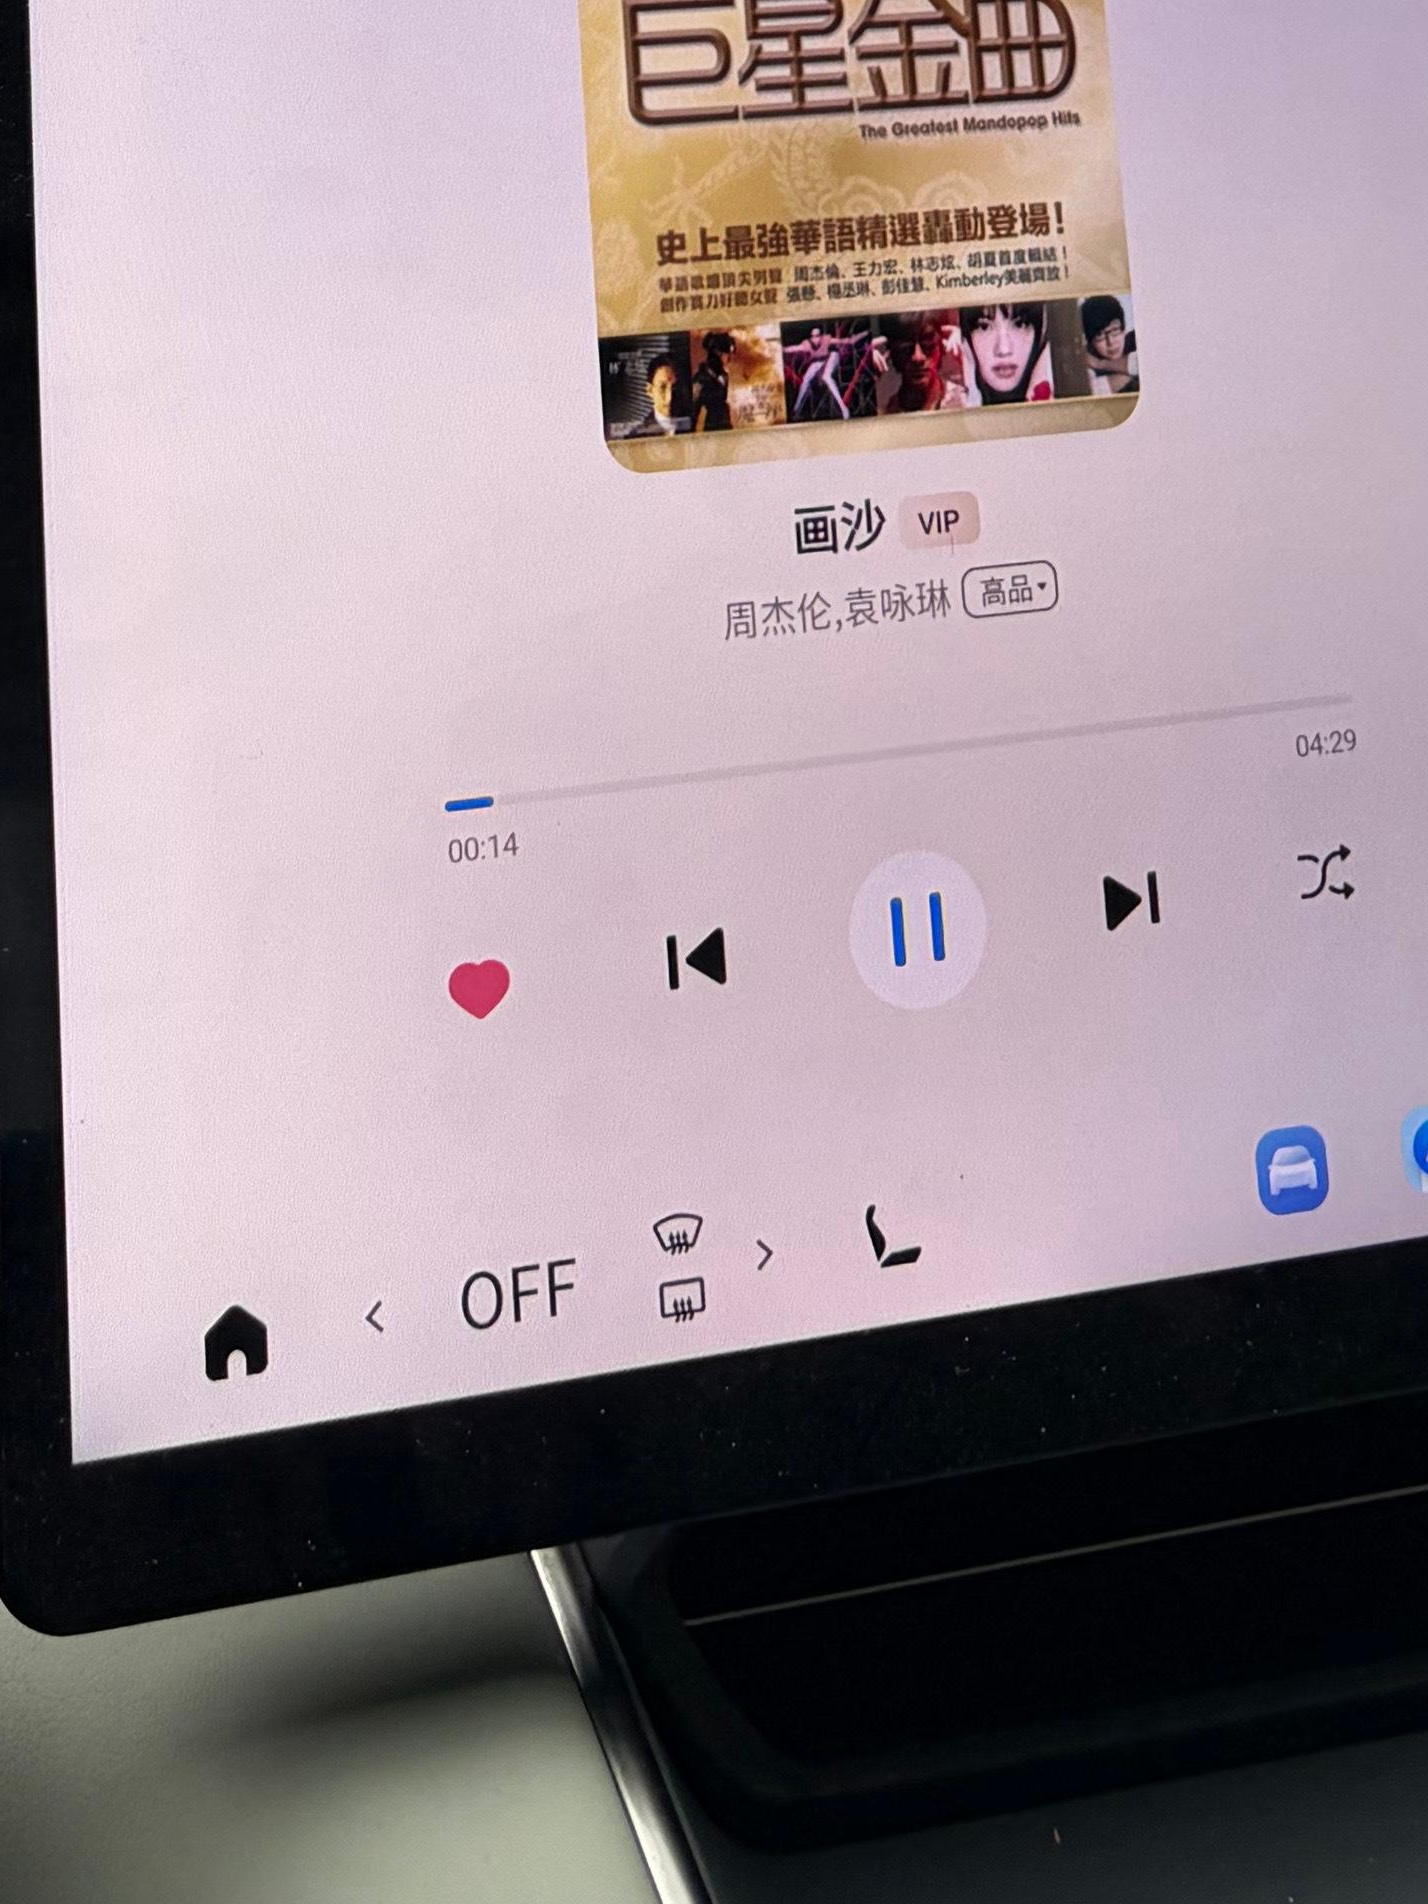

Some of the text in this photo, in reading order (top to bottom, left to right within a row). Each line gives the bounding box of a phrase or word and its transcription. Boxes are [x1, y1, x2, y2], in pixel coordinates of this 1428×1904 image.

[859, 111, 1080, 139] The Greatest Mandopop Hits
[794, 499, 960, 554] 画沙 VIP
[725, 574, 1033, 640] 周杰伦,袁咏琳 高品
[1295, 728, 1357, 759] 04:29
[447, 831, 519, 865] 00:14
[461, 1258, 576, 1329] OFF
